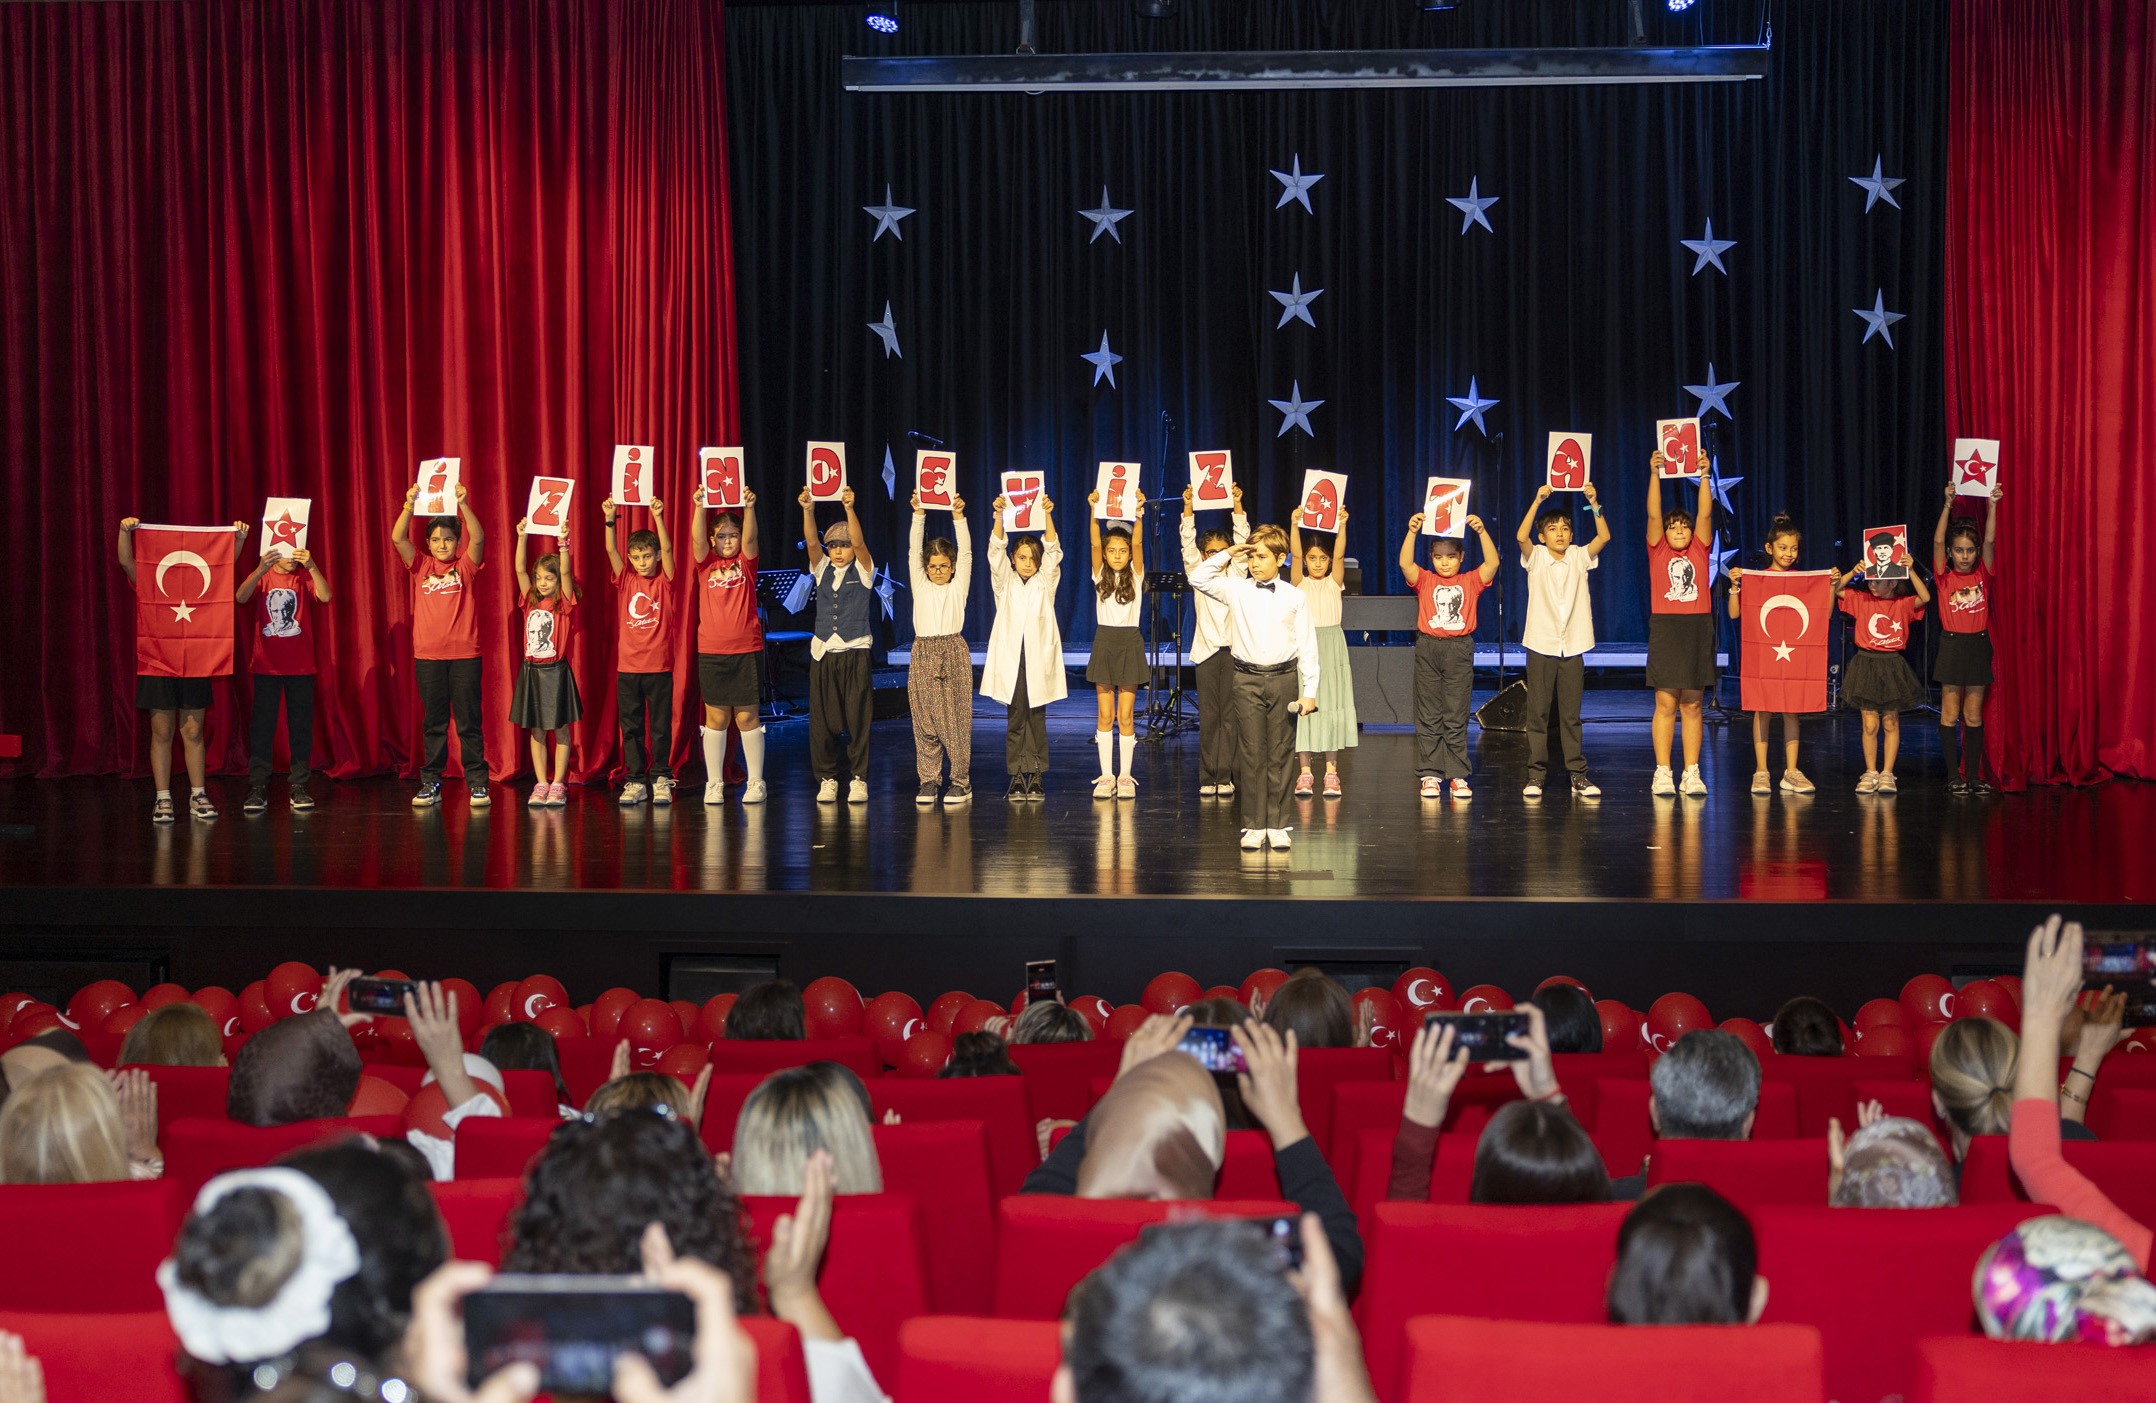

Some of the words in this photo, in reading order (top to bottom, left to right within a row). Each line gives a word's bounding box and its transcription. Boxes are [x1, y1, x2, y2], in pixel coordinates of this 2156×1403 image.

[811, 448, 841, 496] D
[1550, 439, 1584, 489] A
[1662, 423, 1698, 474] M
[706, 457, 740, 504] N
[920, 457, 951, 505] E
[1195, 453, 1228, 500] Z
[532, 479, 569, 526] Z
[1006, 477, 1040, 528] Y
[1303, 479, 1338, 529] A
[1430, 484, 1463, 533] T
